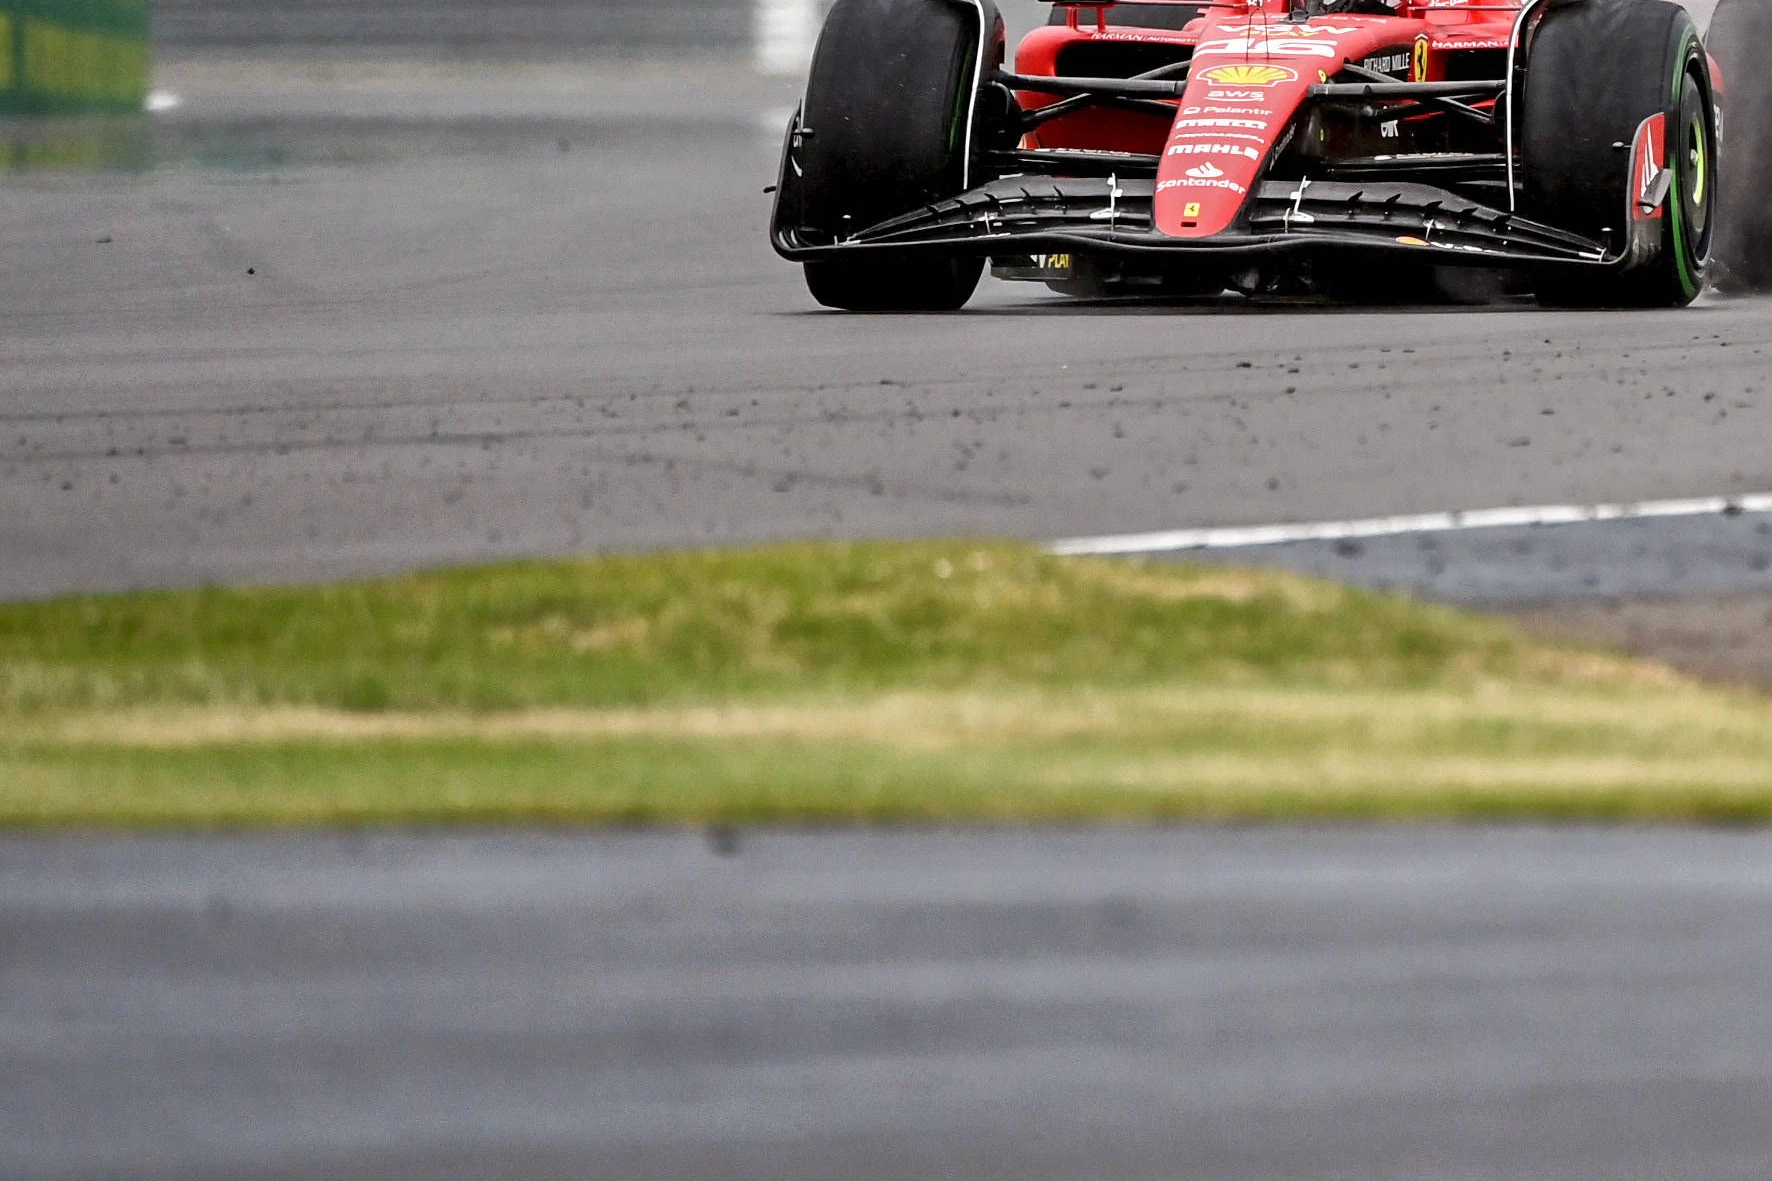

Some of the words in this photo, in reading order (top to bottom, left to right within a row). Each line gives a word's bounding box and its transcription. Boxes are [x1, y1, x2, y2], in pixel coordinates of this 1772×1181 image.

[1432, 40, 1498, 48] HARMAN
[1207, 90, 1264, 99] aws
[1203, 106, 1272, 116] Palantir
[1167, 144, 1260, 161] MAHLE
[1156, 178, 1246, 195] Santander
